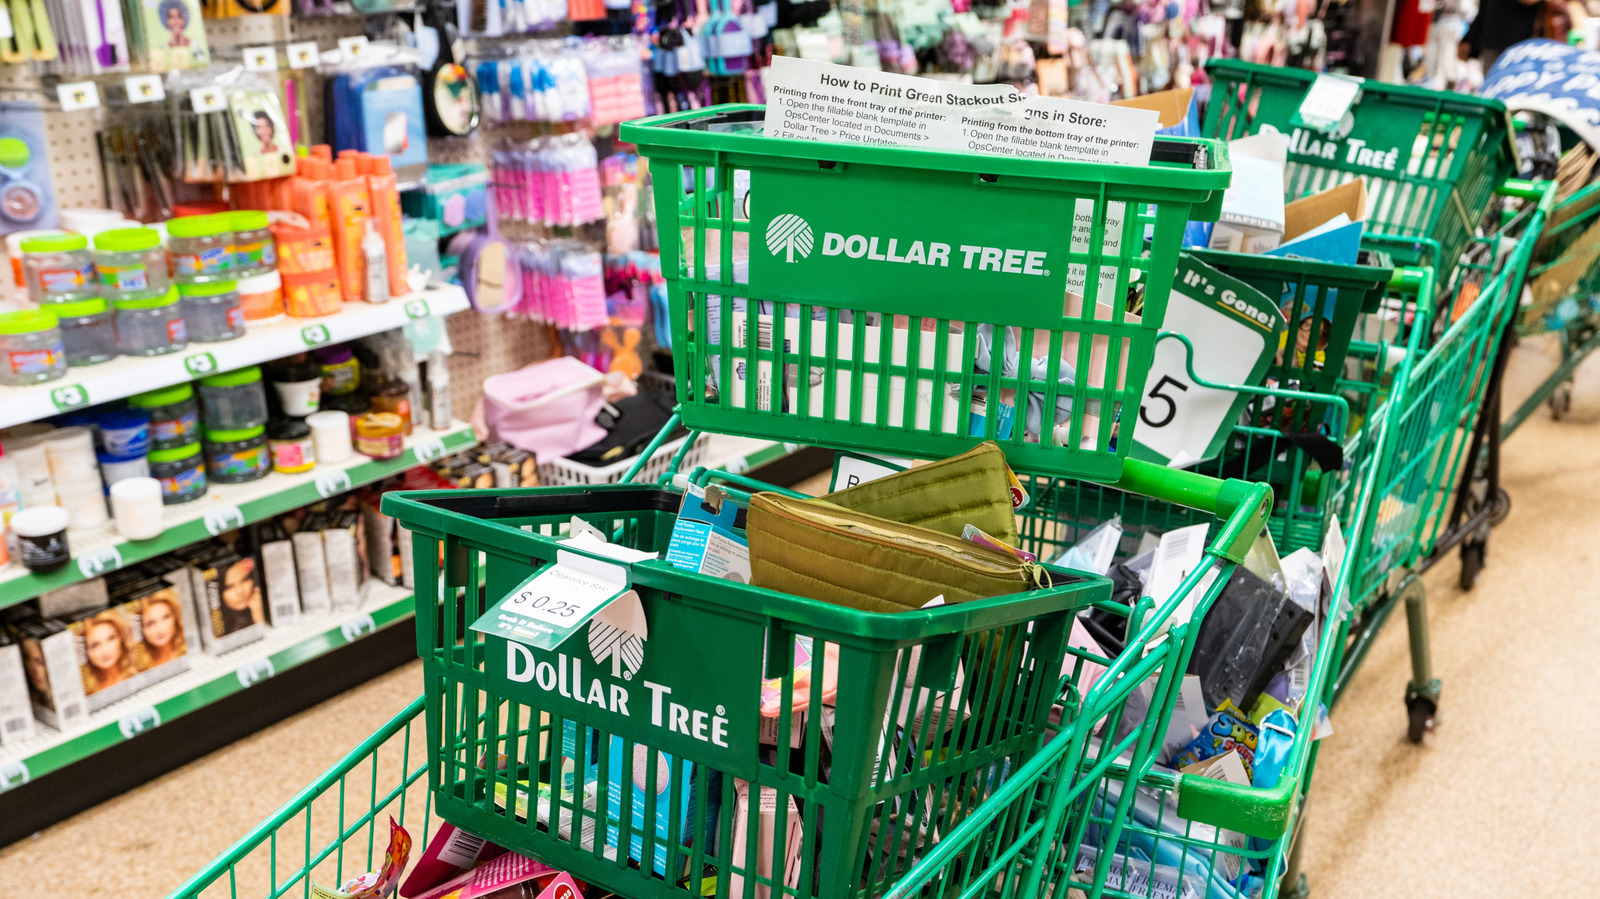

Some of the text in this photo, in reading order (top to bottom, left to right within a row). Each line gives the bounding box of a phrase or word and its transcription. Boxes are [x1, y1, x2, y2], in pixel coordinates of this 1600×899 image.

[773, 85, 946, 122] Printing from the front tray of the printer:
[820, 73, 849, 88] How
[853, 80, 866, 91] to
[870, 82, 902, 98] Print
[905, 88, 943, 104] Green
[946, 93, 1004, 106] Stackout
[778, 97, 926, 130] 1. Open the fillable blank template in
[784, 109, 831, 126] OpsCenter
[832, 118, 862, 132] located
[864, 124, 872, 132] in
[874, 125, 922, 142] Documents
[1053, 110, 1065, 122] in
[1068, 112, 1107, 128] Store:
[783, 120, 809, 132] Dollar
[810, 125, 830, 136] Tree
[839, 130, 860, 142] Price
[961, 116, 1140, 150] Printing from the bottom tray of the printer:
[962, 128, 1109, 157] 1. Open the fillable blank template in
[968, 140, 1014, 155] OpsCenter
[1347, 138, 1398, 170] TREE
[1226, 212, 1278, 228] HAPPIER
[822, 232, 950, 268] DOLLAR
[1078, 268, 1085, 276] is
[1184, 269, 1276, 327] It's Gone!
[550, 570, 609, 592] Clearance Sale
[514, 591, 580, 617] $ 0.25
[498, 622, 540, 638] It's Gone!
[526, 620, 554, 633] Before
[506, 640, 630, 716] DOLLAR
